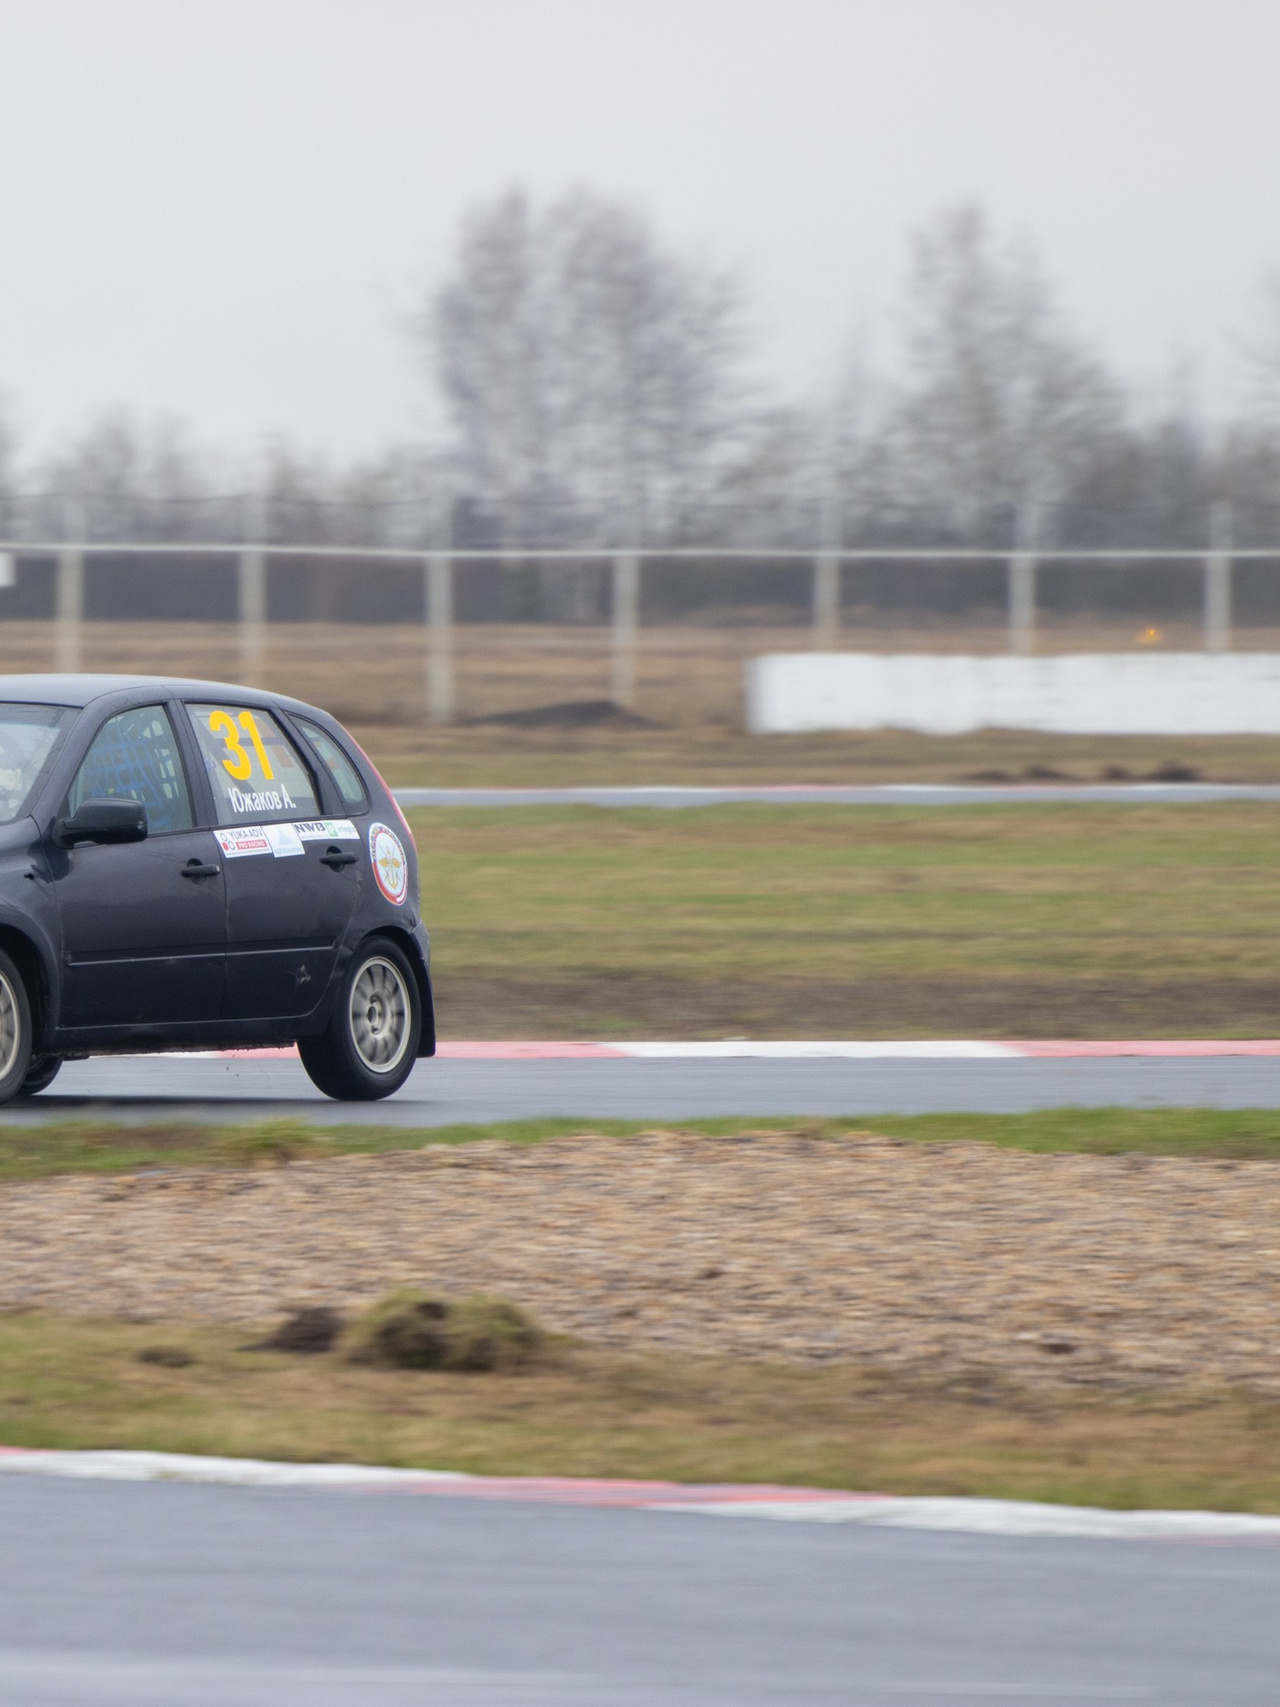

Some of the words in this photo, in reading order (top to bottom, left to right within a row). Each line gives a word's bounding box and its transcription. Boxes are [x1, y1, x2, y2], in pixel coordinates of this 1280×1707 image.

[209, 710, 274, 780] 31
[227, 787, 282, 813] Южаков
[228, 829, 249, 840] YUKA
[294, 822, 326, 833] NWB
